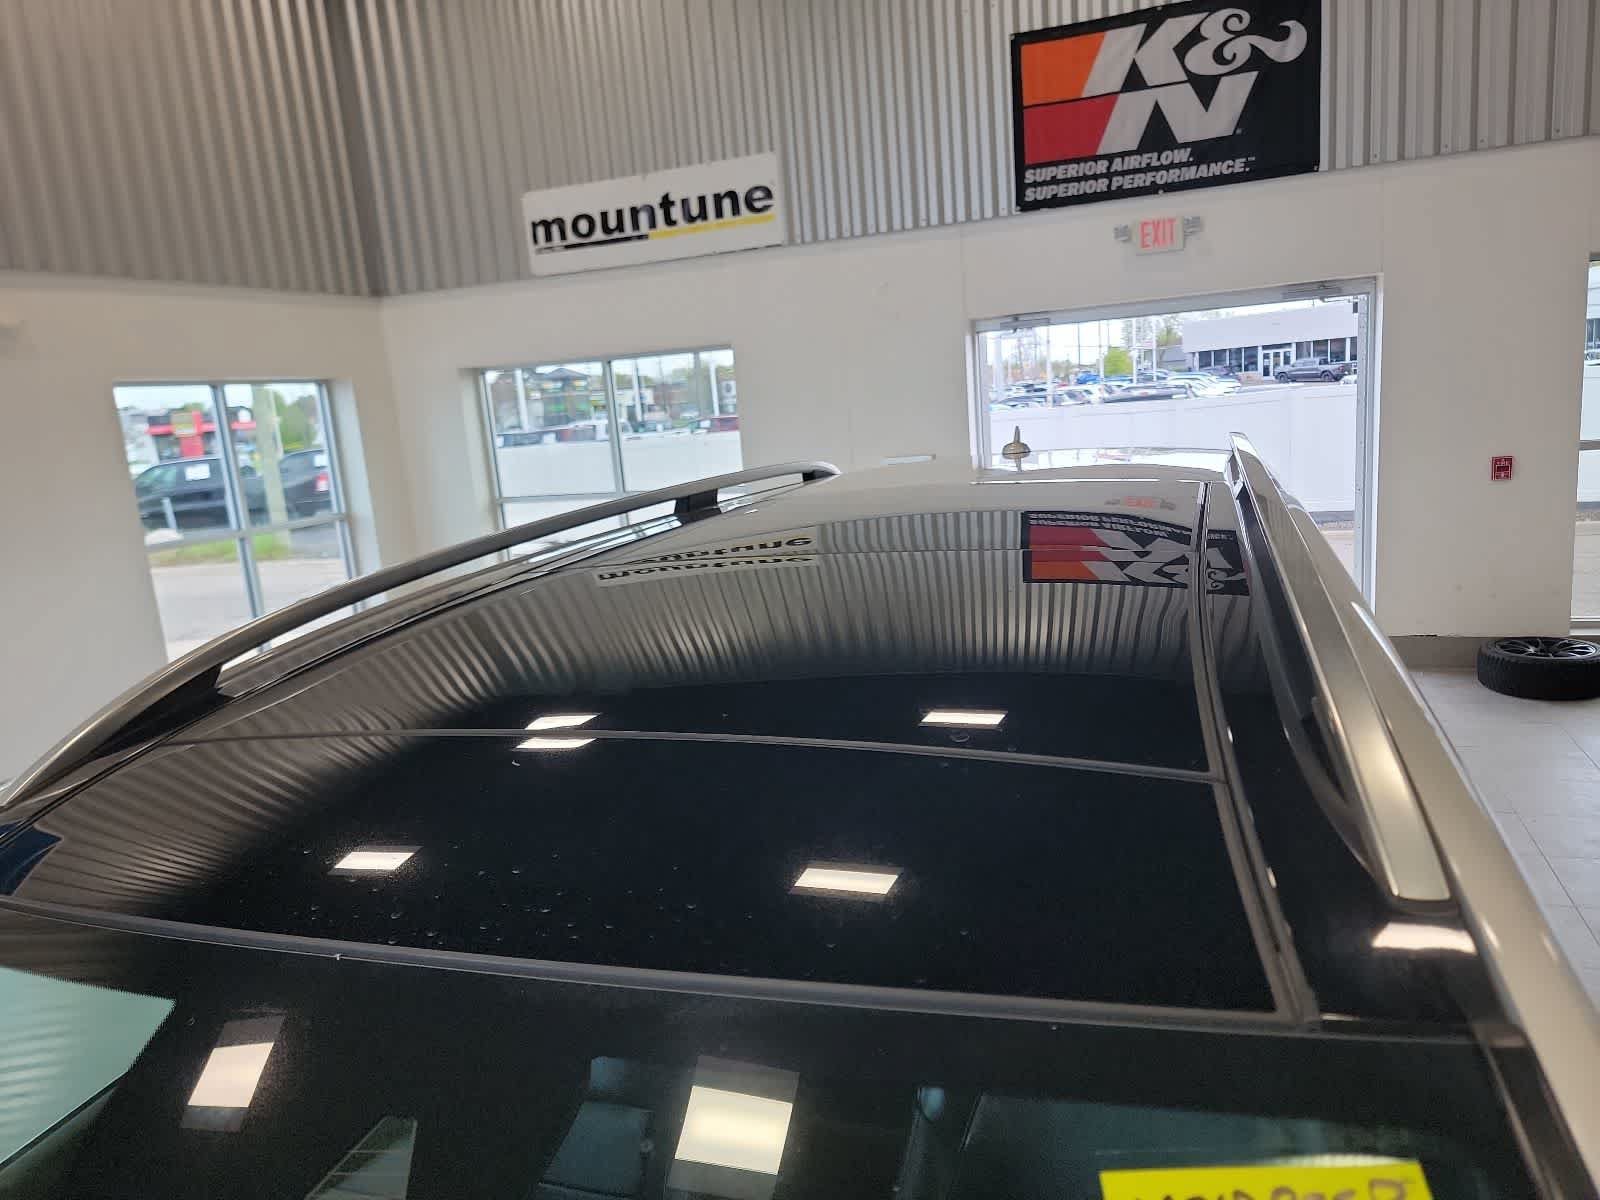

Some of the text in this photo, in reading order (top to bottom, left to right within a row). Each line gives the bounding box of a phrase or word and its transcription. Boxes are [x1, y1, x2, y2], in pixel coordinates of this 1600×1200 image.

[1024, 147, 1194, 183] SUPERIOR AIRFLOW.
[1024, 176, 1108, 201] SUPERIOR
[533, 185, 773, 245] mountune
[1140, 217, 1177, 250] EXIT
